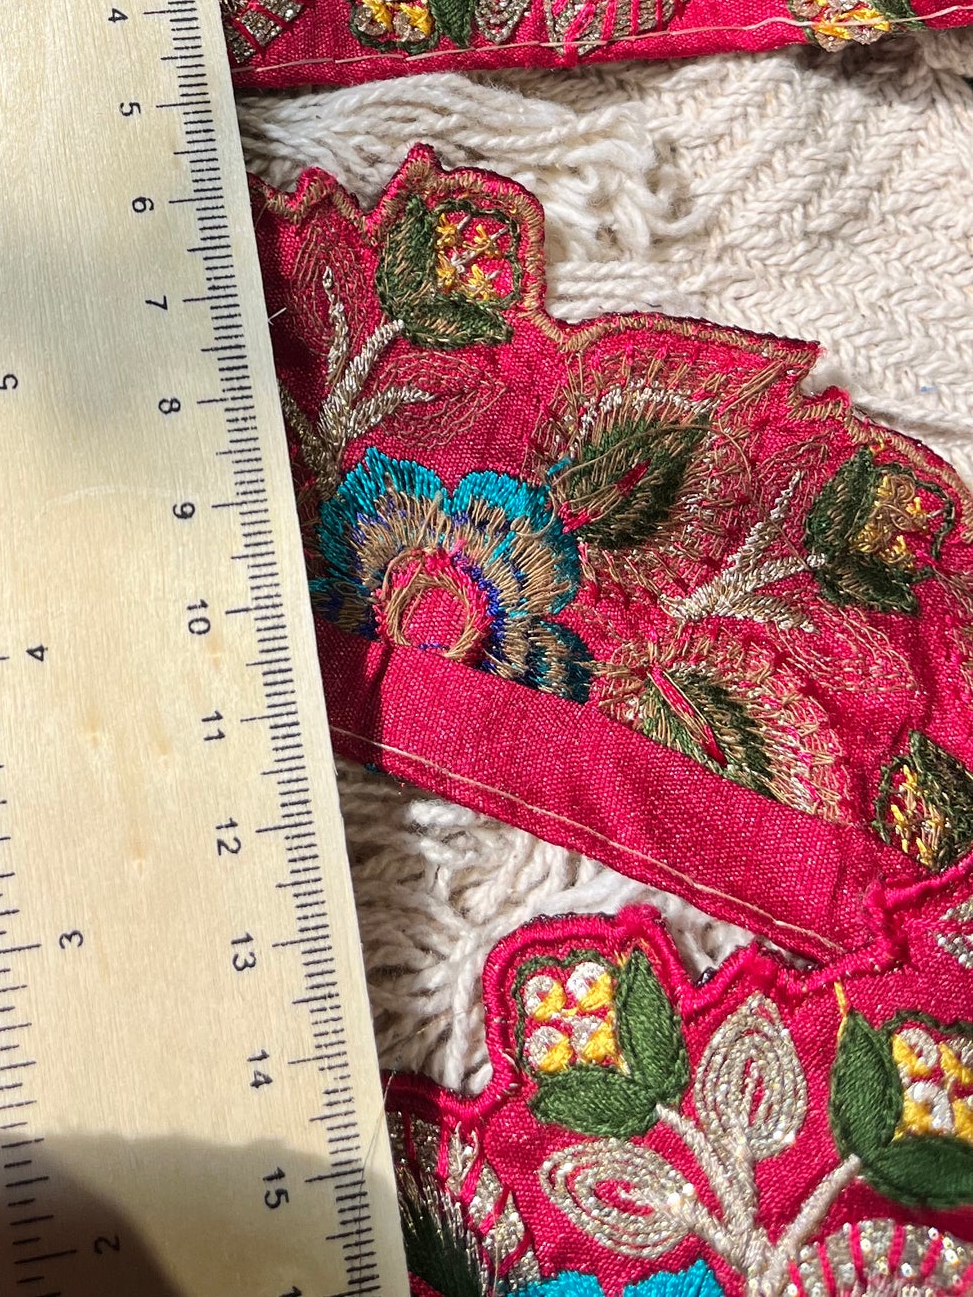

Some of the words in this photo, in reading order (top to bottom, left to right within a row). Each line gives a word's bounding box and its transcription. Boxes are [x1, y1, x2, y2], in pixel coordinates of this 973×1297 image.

[107, 7, 129, 24] 4
[119, 101, 142, 117] 5
[131, 196, 155, 214] 6
[144, 295, 168, 311] 7
[158, 397, 182, 415] 8
[172, 502, 196, 520] 9
[186, 599, 211, 636] 10
[25, 644, 49, 663] 4
[201, 710, 226, 742] 11
[215, 817, 242, 856] 12
[58, 930, 84, 950] 3
[230, 932, 257, 972] 13
[247, 1049, 273, 1089] 14
[262, 1167, 290, 1210] 15
[91, 1233, 122, 1256] 2
